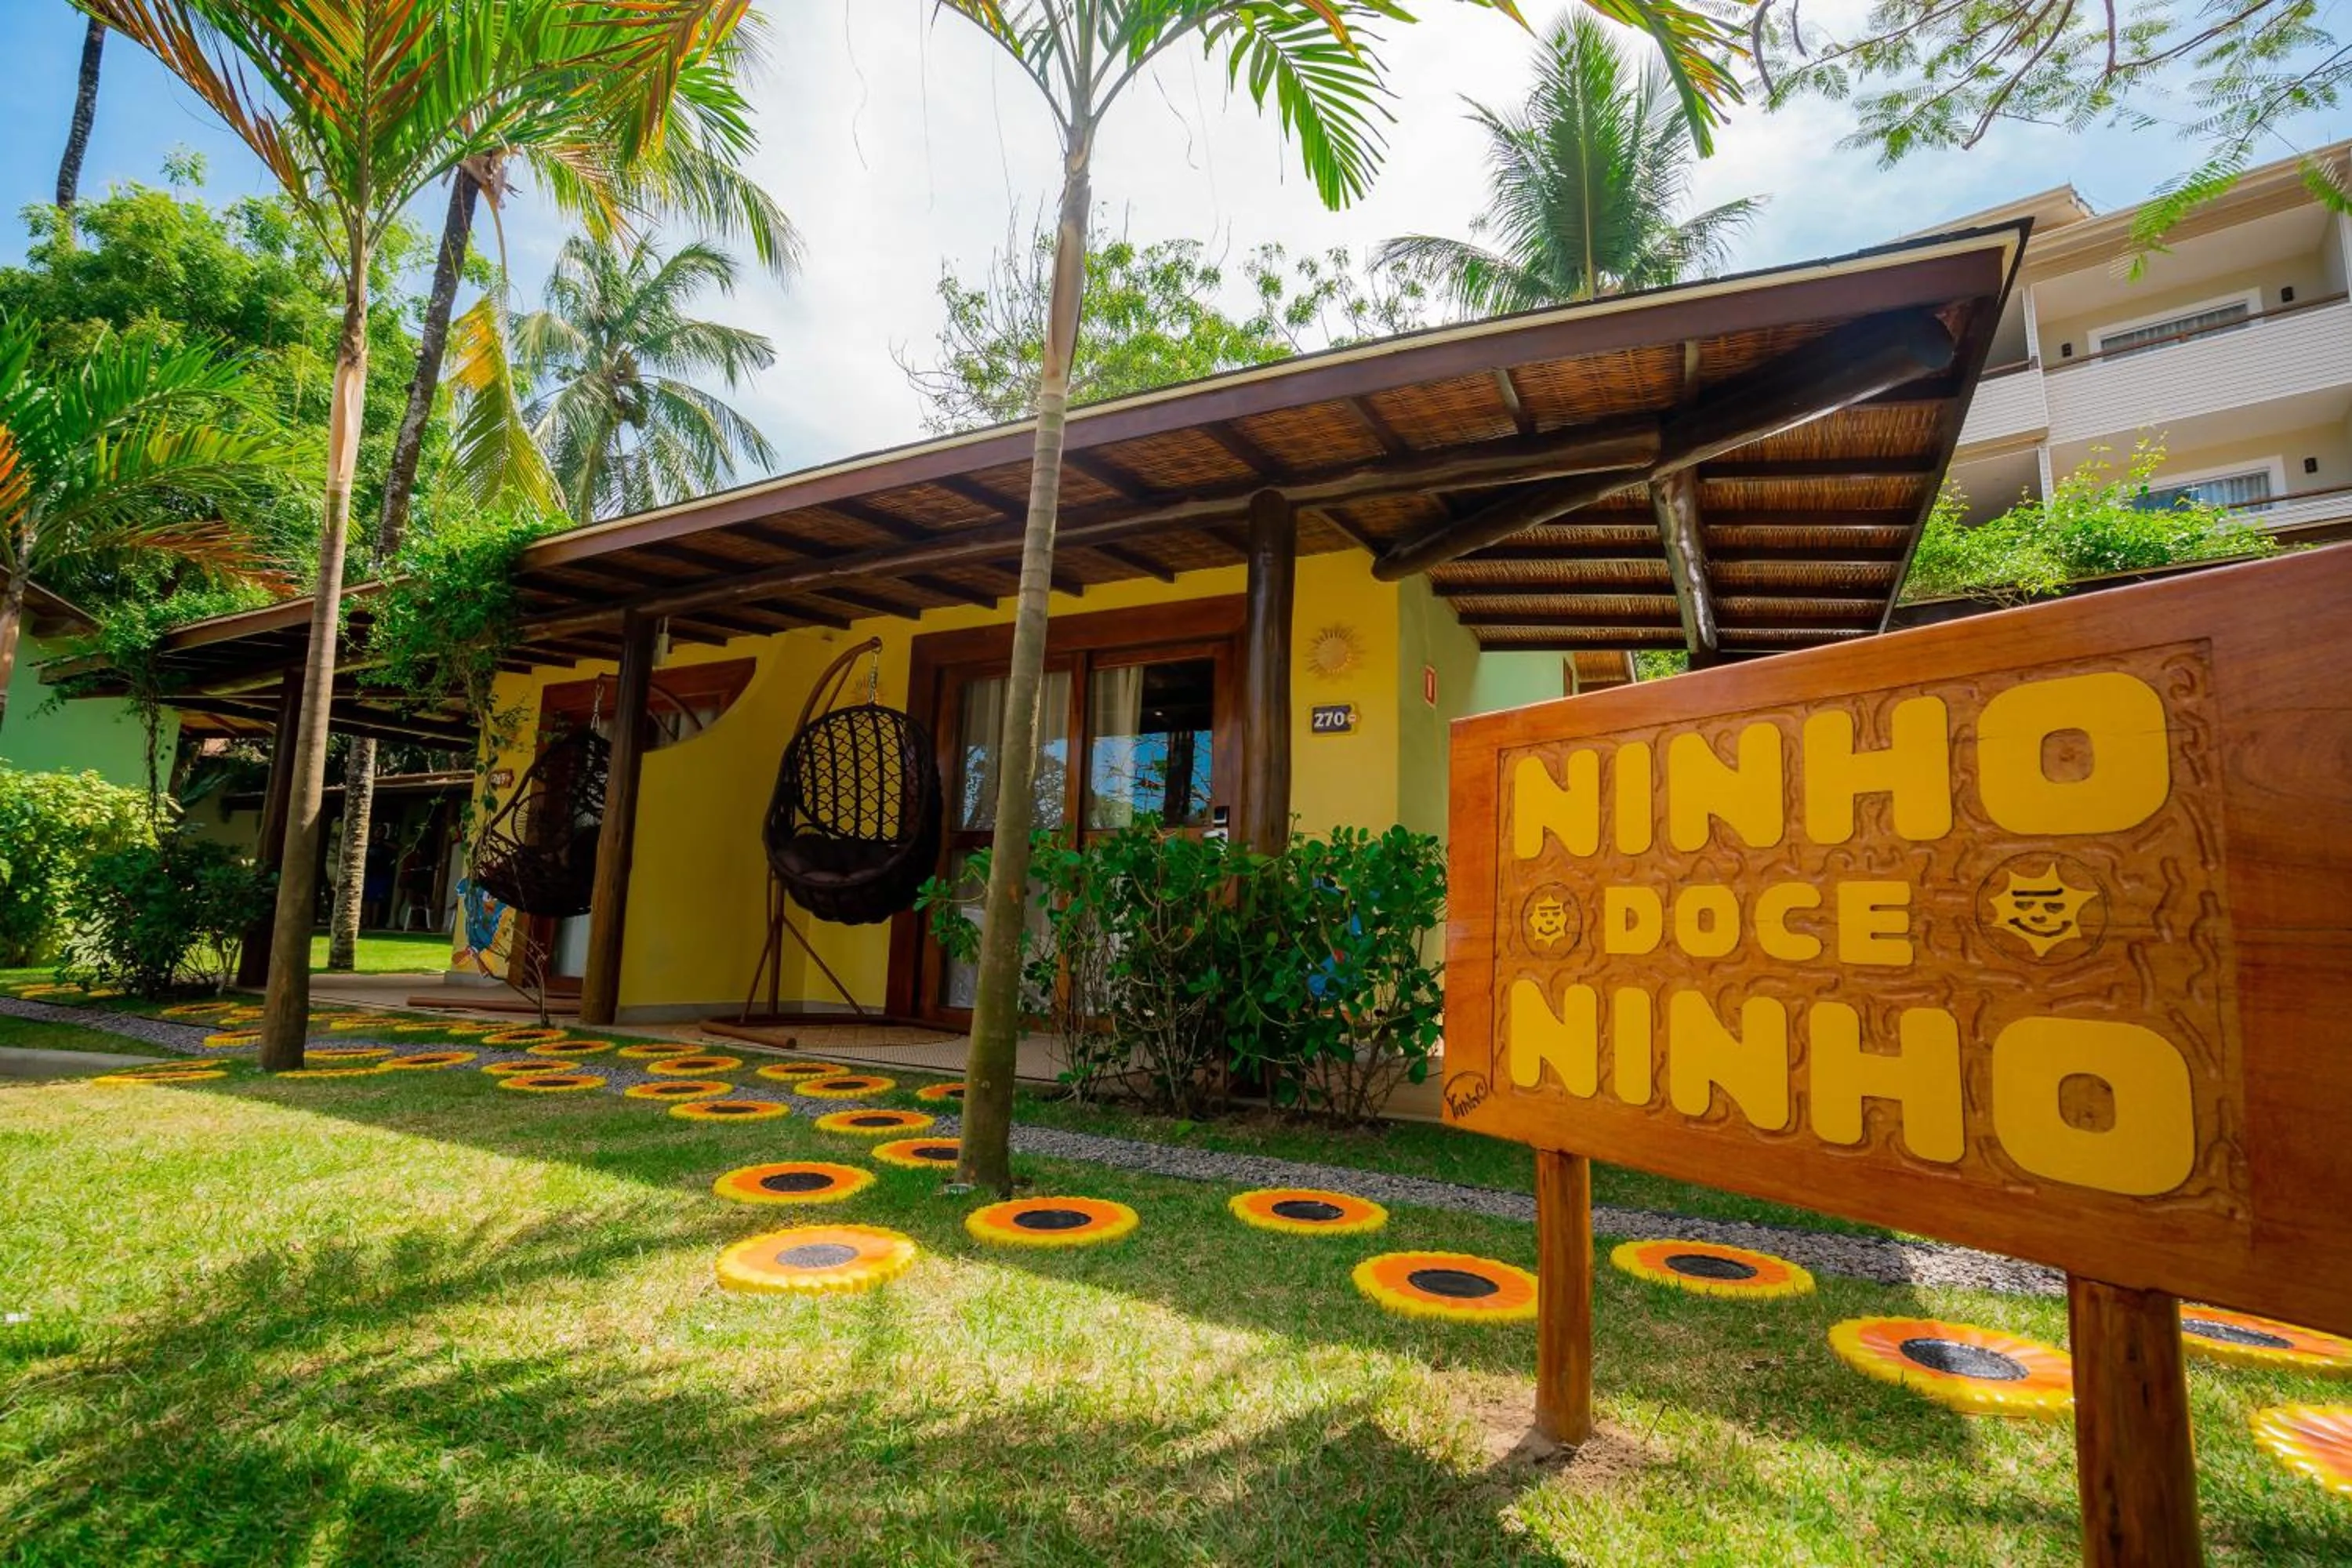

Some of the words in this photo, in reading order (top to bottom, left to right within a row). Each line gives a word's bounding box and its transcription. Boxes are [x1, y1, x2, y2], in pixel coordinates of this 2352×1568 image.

[1314, 712, 1345, 728] 270
[1512, 670, 2170, 859] NINHO
[1604, 880, 1914, 966] DOCE
[1509, 978, 2195, 1196] NINHO
